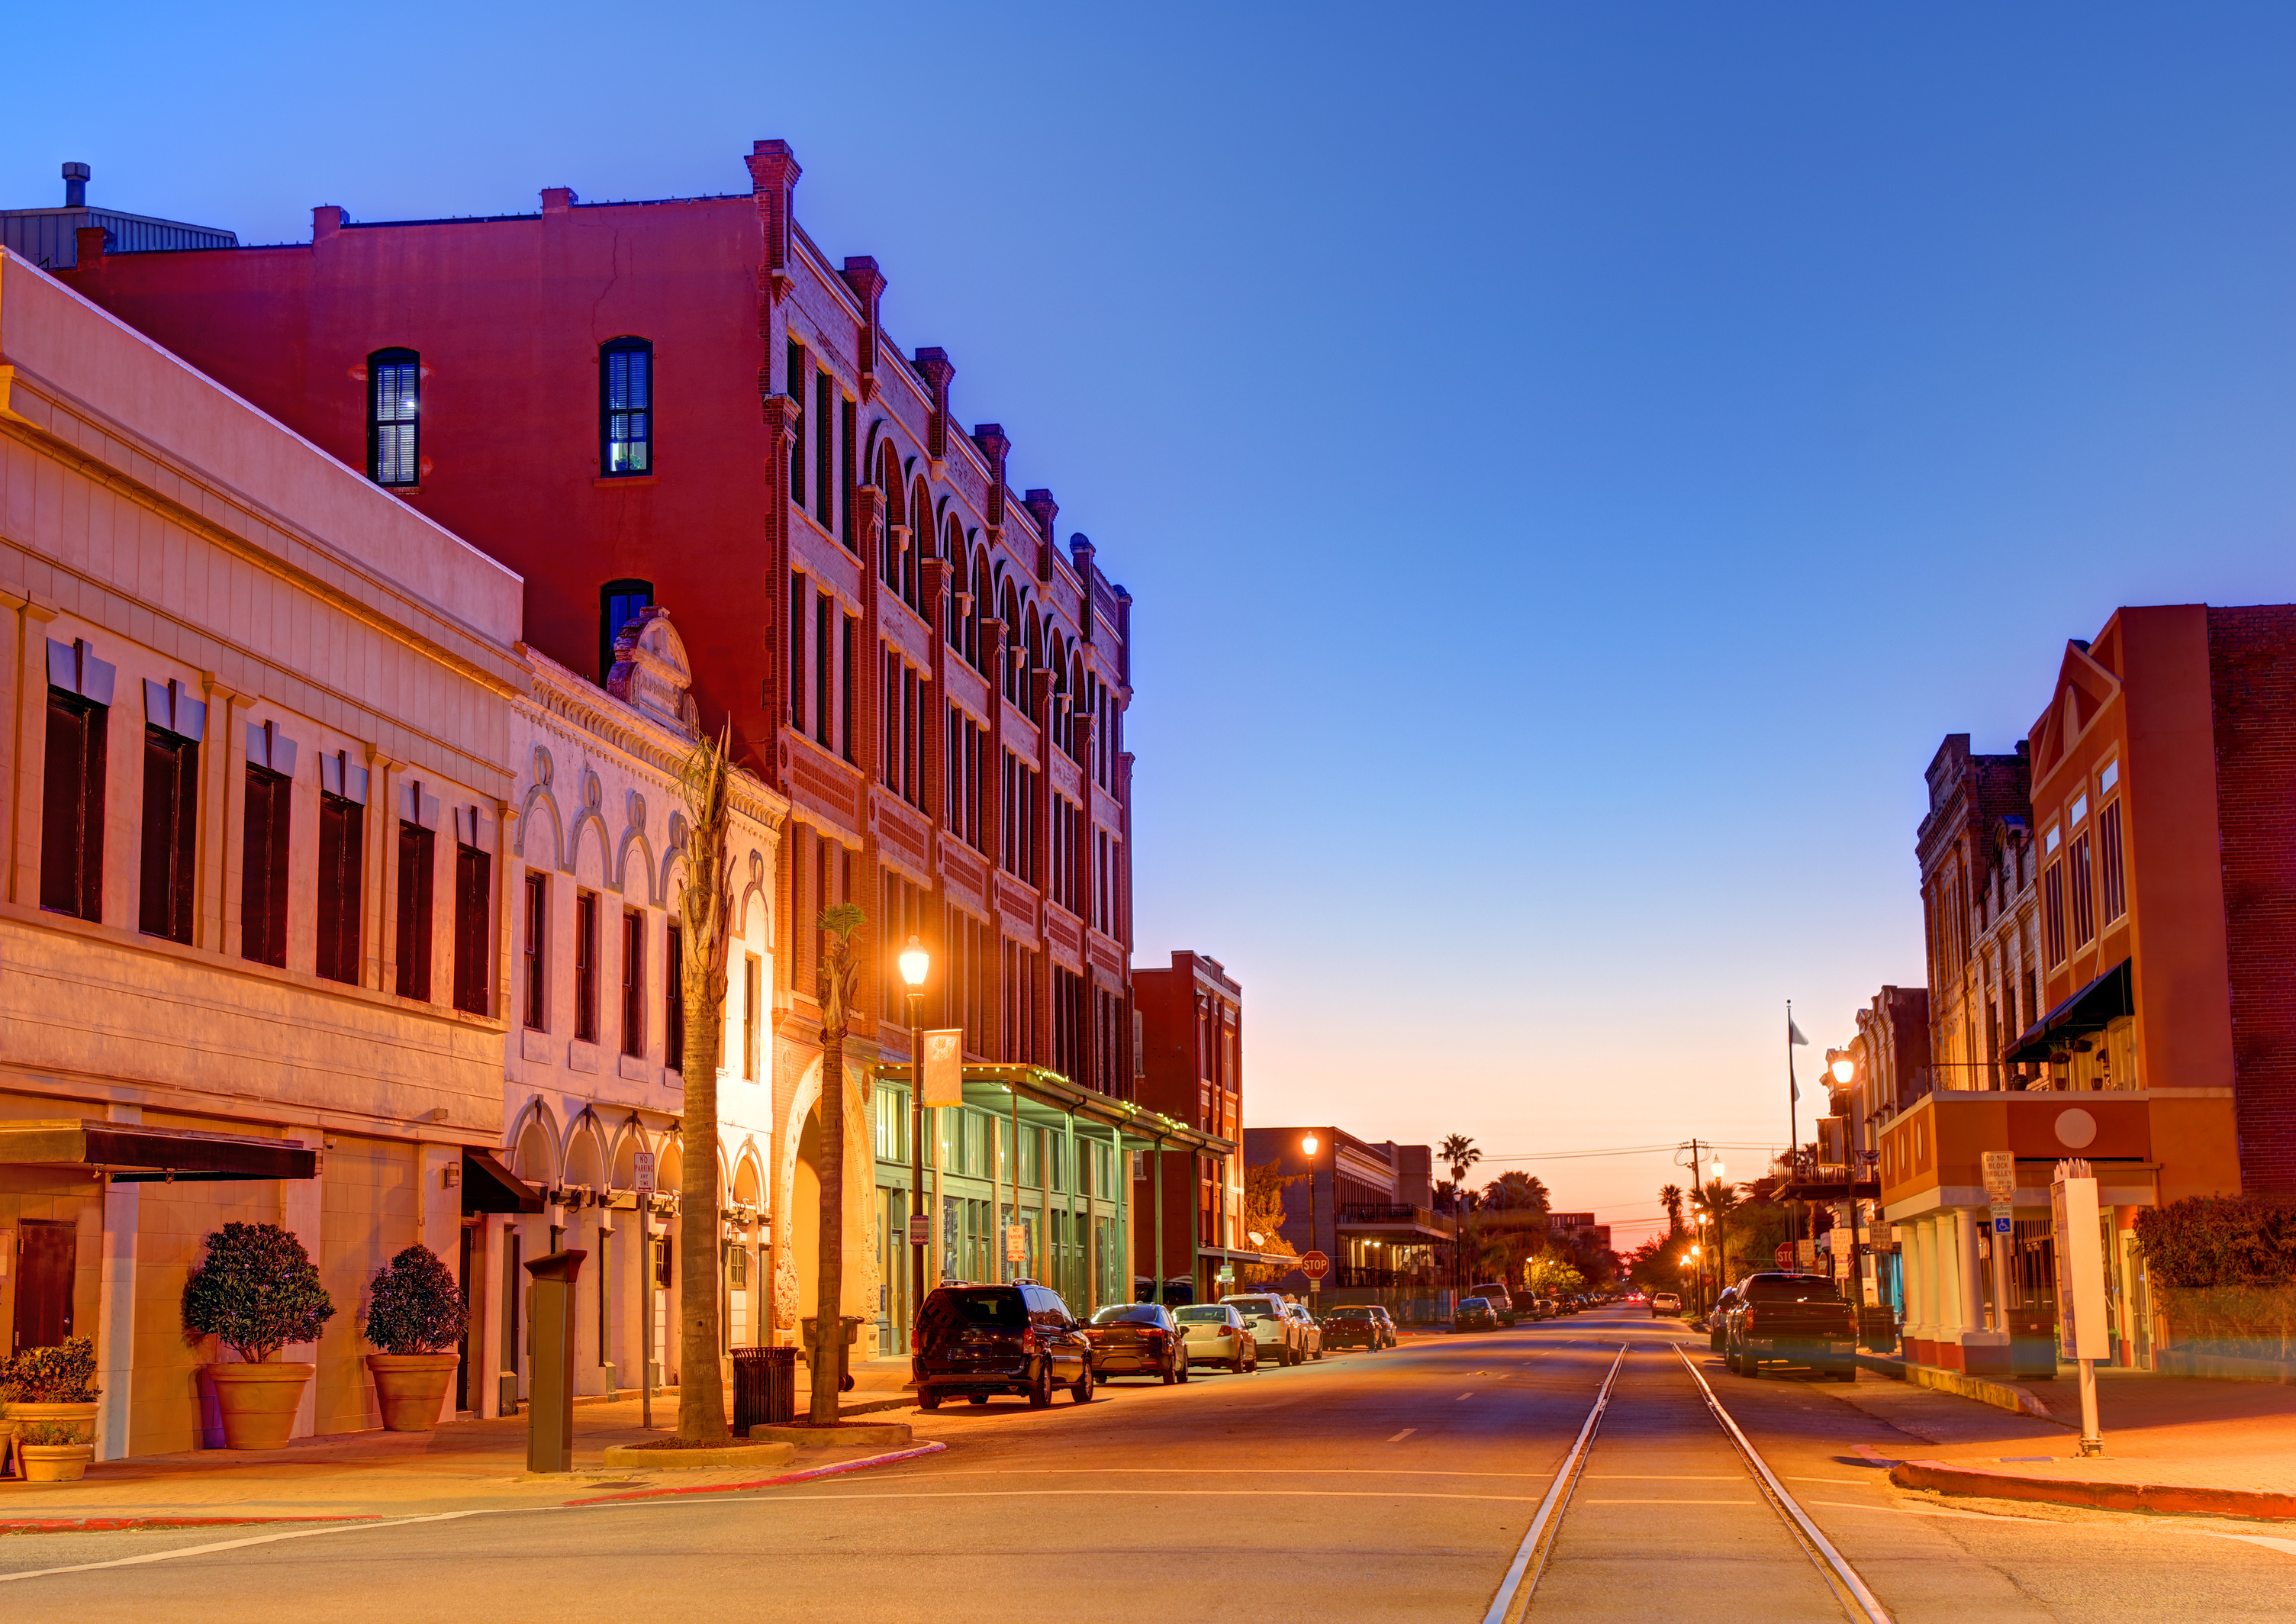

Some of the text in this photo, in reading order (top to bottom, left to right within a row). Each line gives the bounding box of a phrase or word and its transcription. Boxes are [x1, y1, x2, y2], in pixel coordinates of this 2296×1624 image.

[1777, 1251, 1793, 1262] STO
[1303, 1259, 1327, 1270] STOP
[1818, 1260, 1827, 1270] STOP
